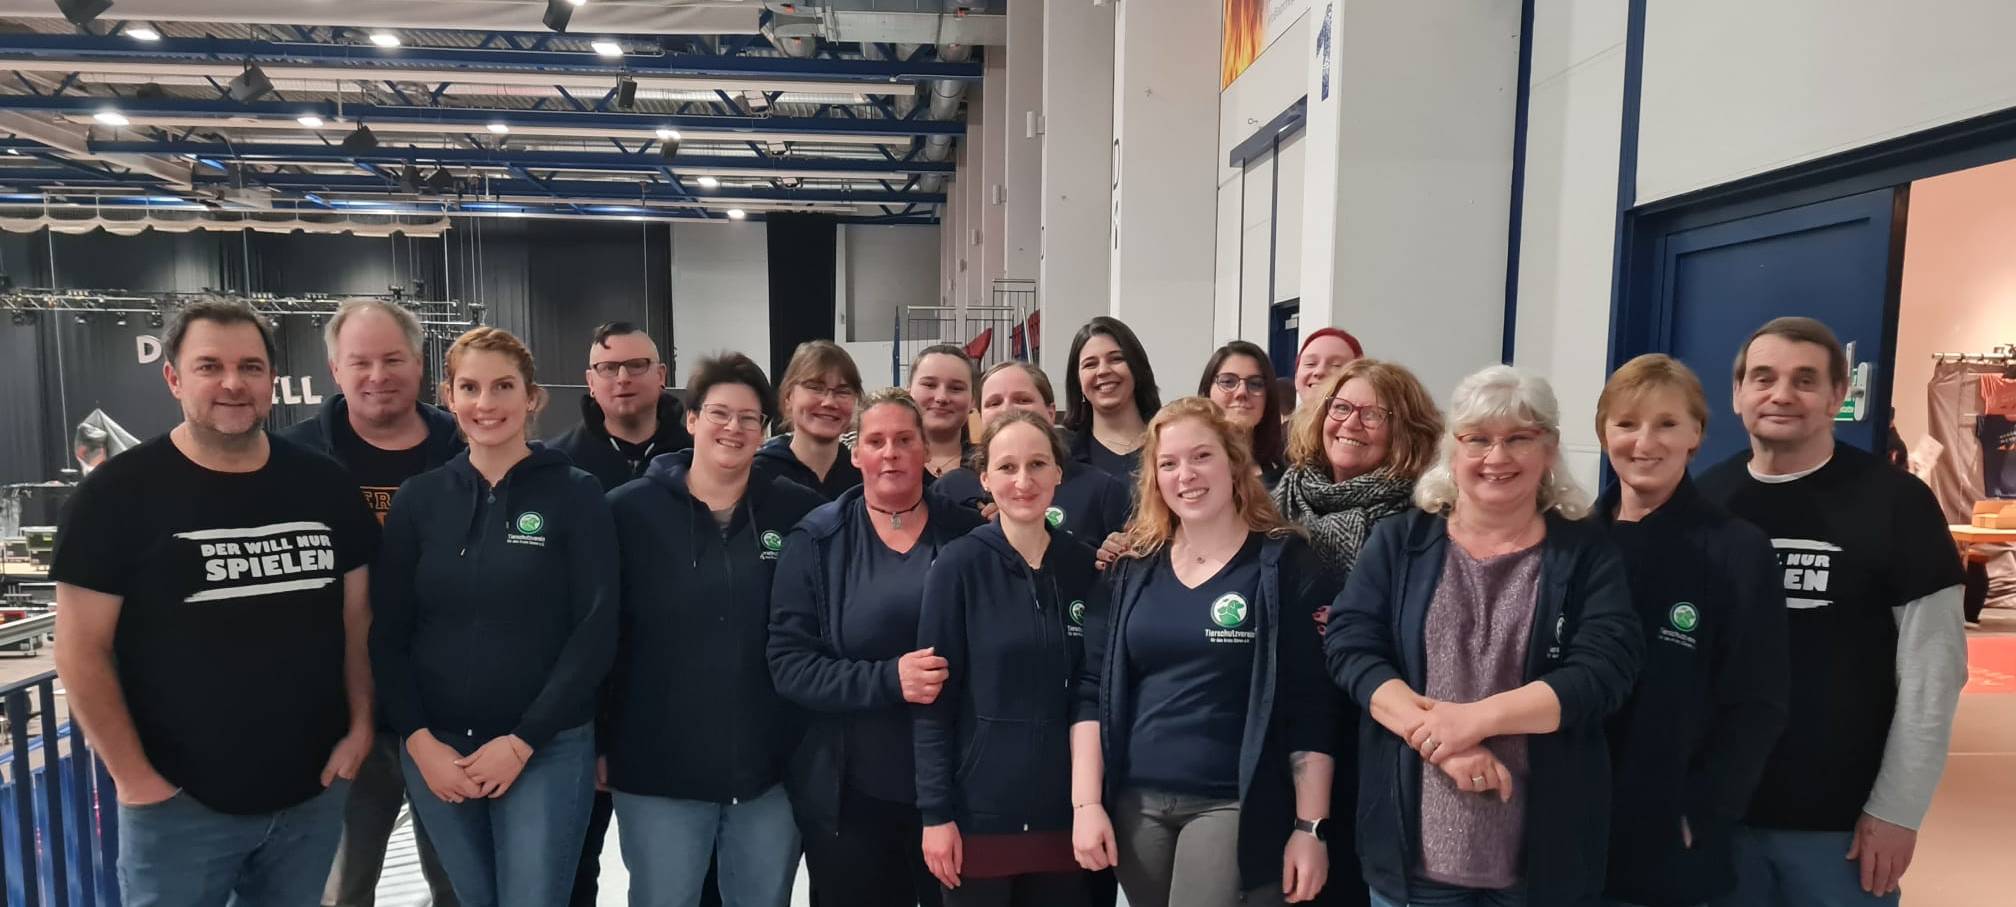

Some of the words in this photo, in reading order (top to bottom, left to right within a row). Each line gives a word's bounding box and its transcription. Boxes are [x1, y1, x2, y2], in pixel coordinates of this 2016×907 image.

[200, 543, 241, 557] DER
[244, 537, 293, 554] WILL
[296, 534, 332, 548] NUR
[205, 549, 335, 581] SPIELEN
[1786, 553, 1830, 568] NUR
